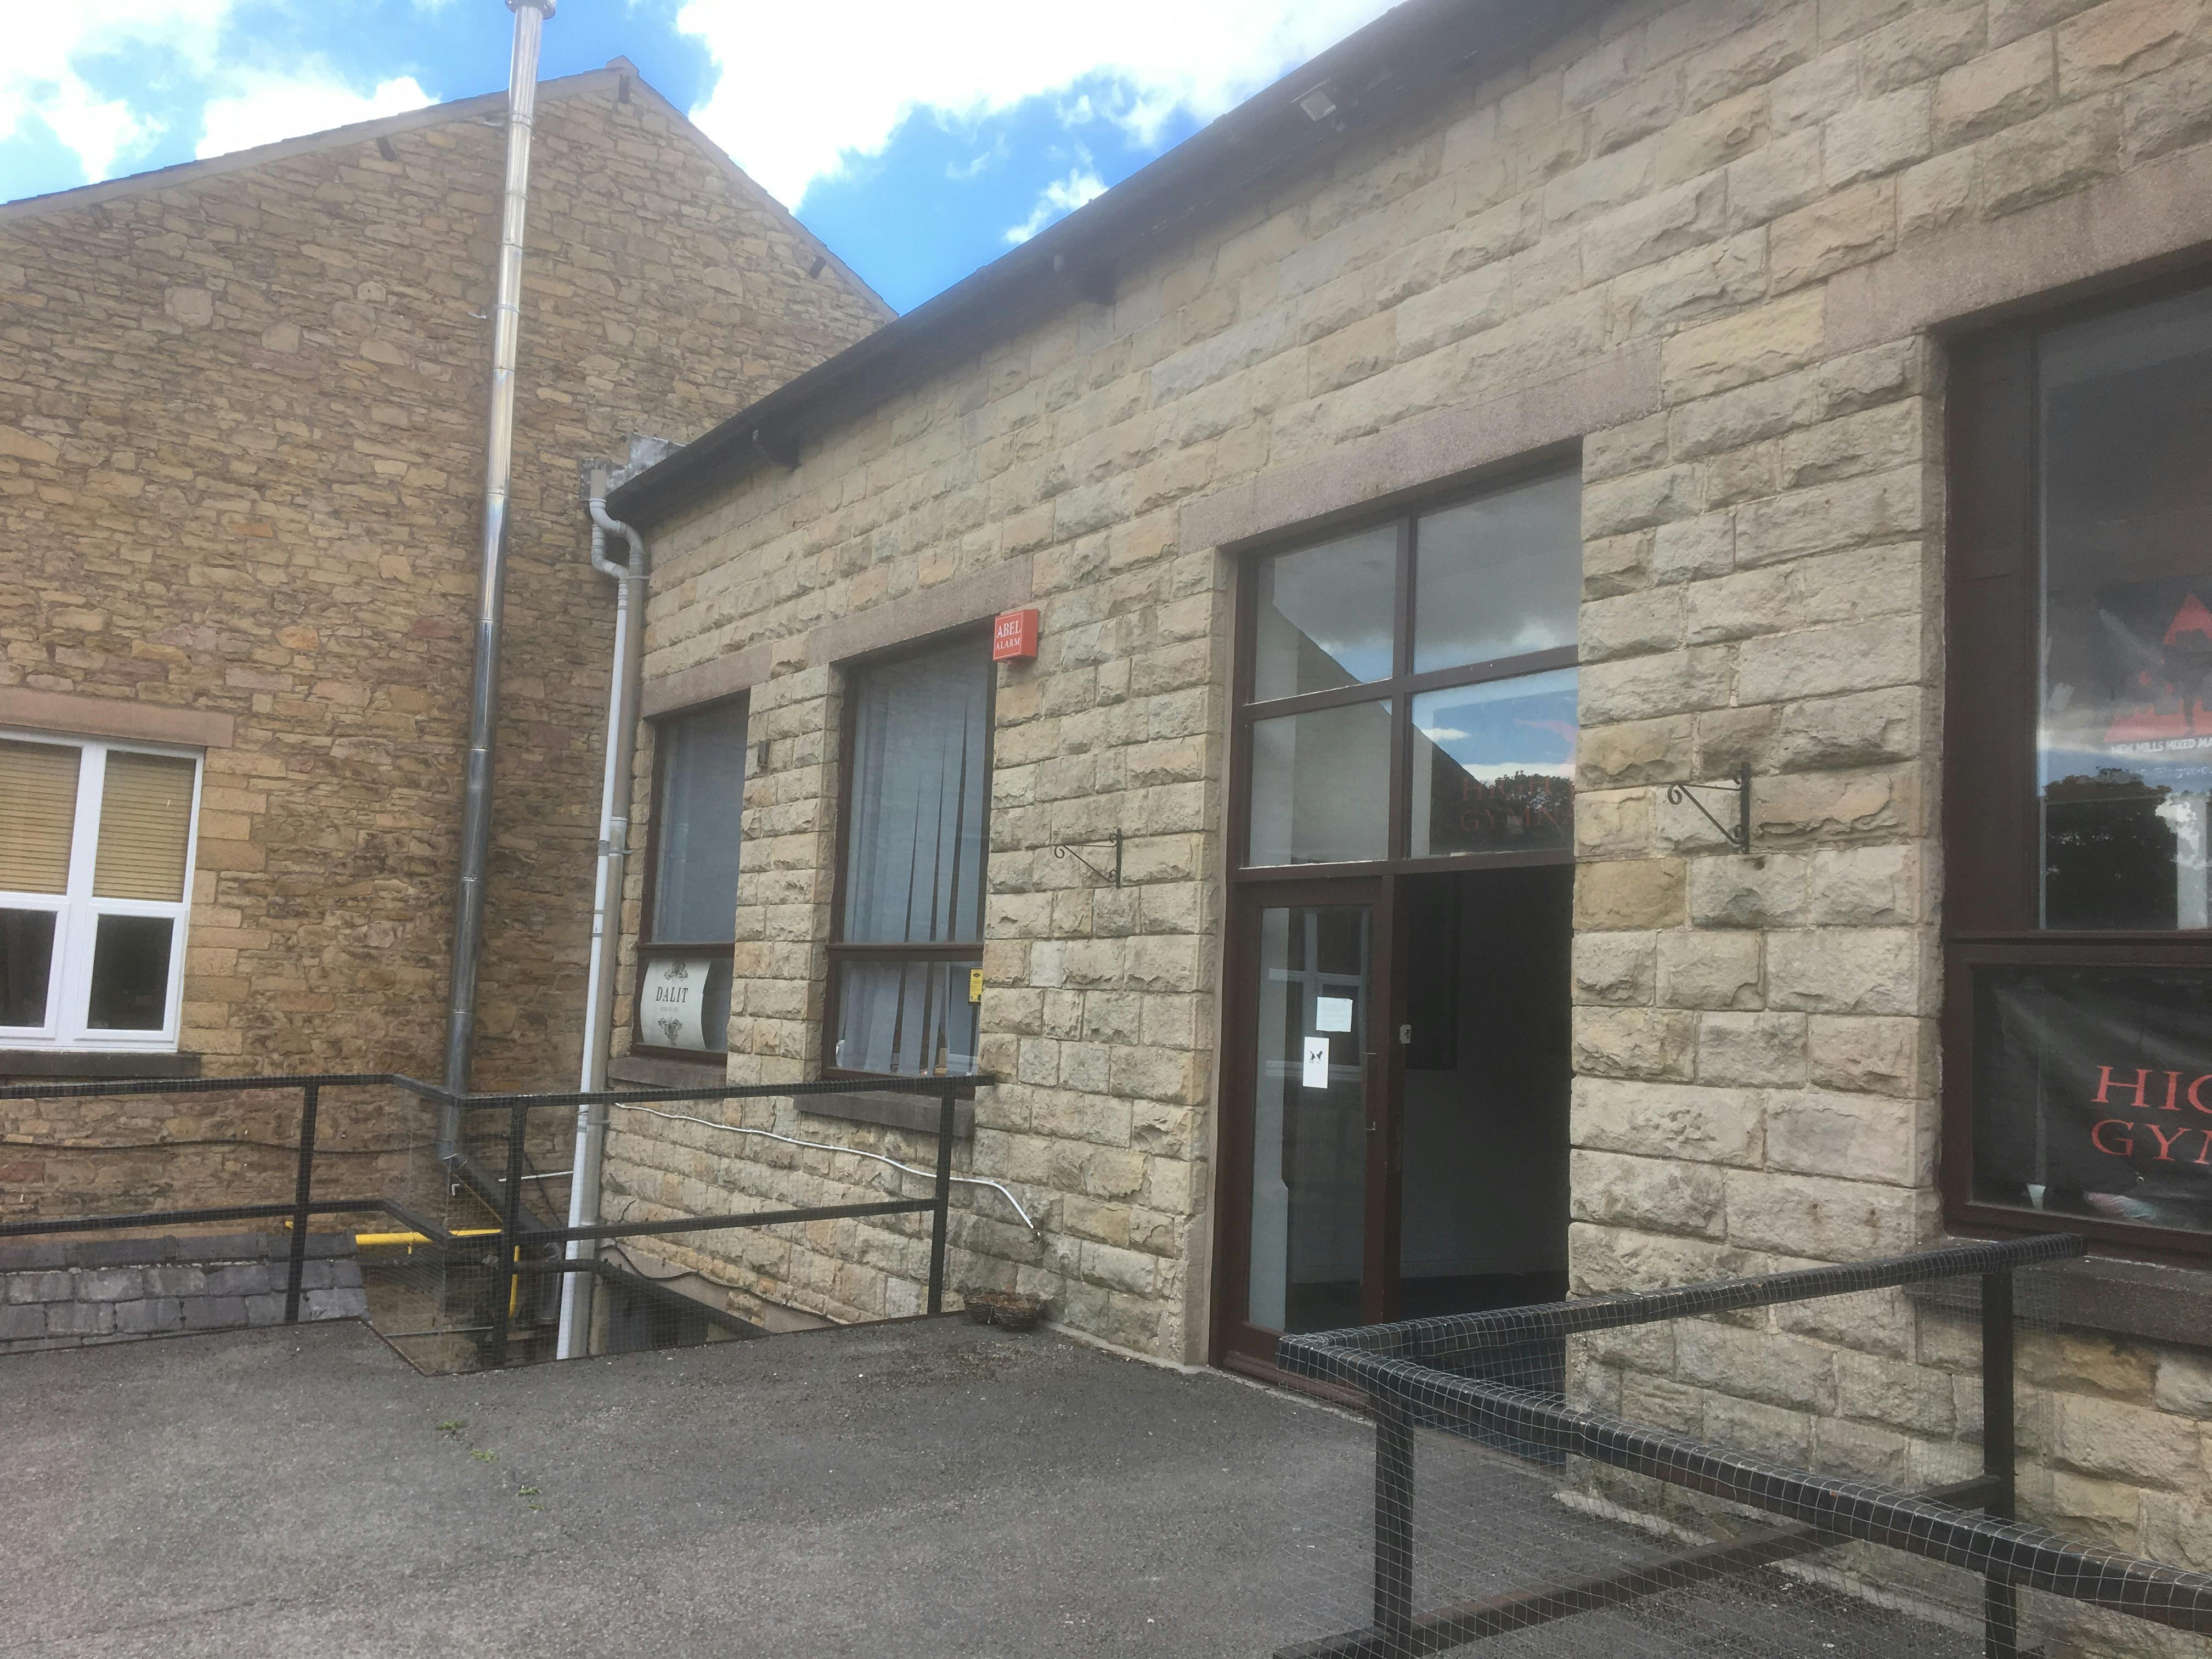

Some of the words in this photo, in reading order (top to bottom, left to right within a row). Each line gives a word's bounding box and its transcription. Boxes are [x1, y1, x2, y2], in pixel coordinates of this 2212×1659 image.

[996, 620, 1021, 638] ABEL
[995, 637, 1020, 651] ALARM
[2136, 741, 2164, 752] MILLS
[2166, 738, 2195, 751] MIXED
[656, 986, 689, 1003] DALIT
